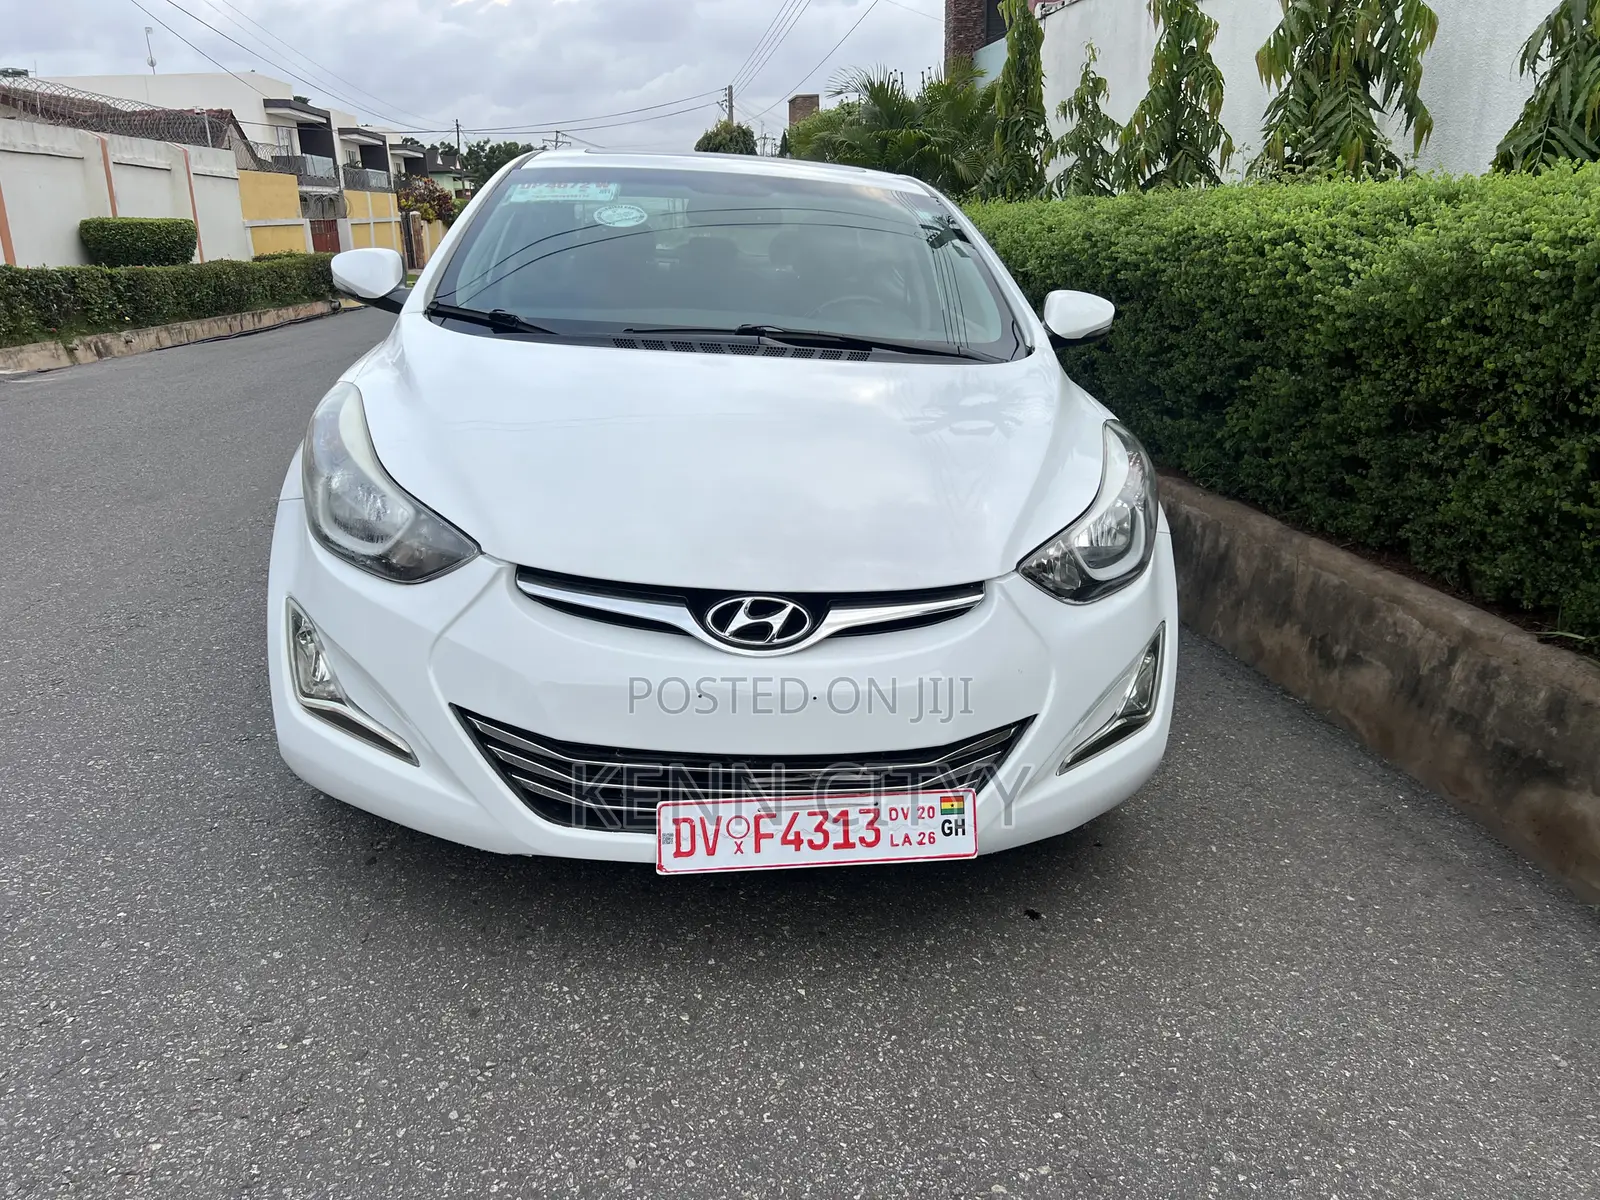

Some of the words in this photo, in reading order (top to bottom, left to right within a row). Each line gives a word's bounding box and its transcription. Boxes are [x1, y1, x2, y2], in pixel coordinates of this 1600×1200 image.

[889, 807, 909, 821] DV
[917, 805, 935, 819] 20
[672, 815, 722, 859] DV
[754, 809, 881, 853] F4313
[941, 818, 966, 837] GH
[890, 833, 912, 847] LA
[916, 831, 936, 846] 26
